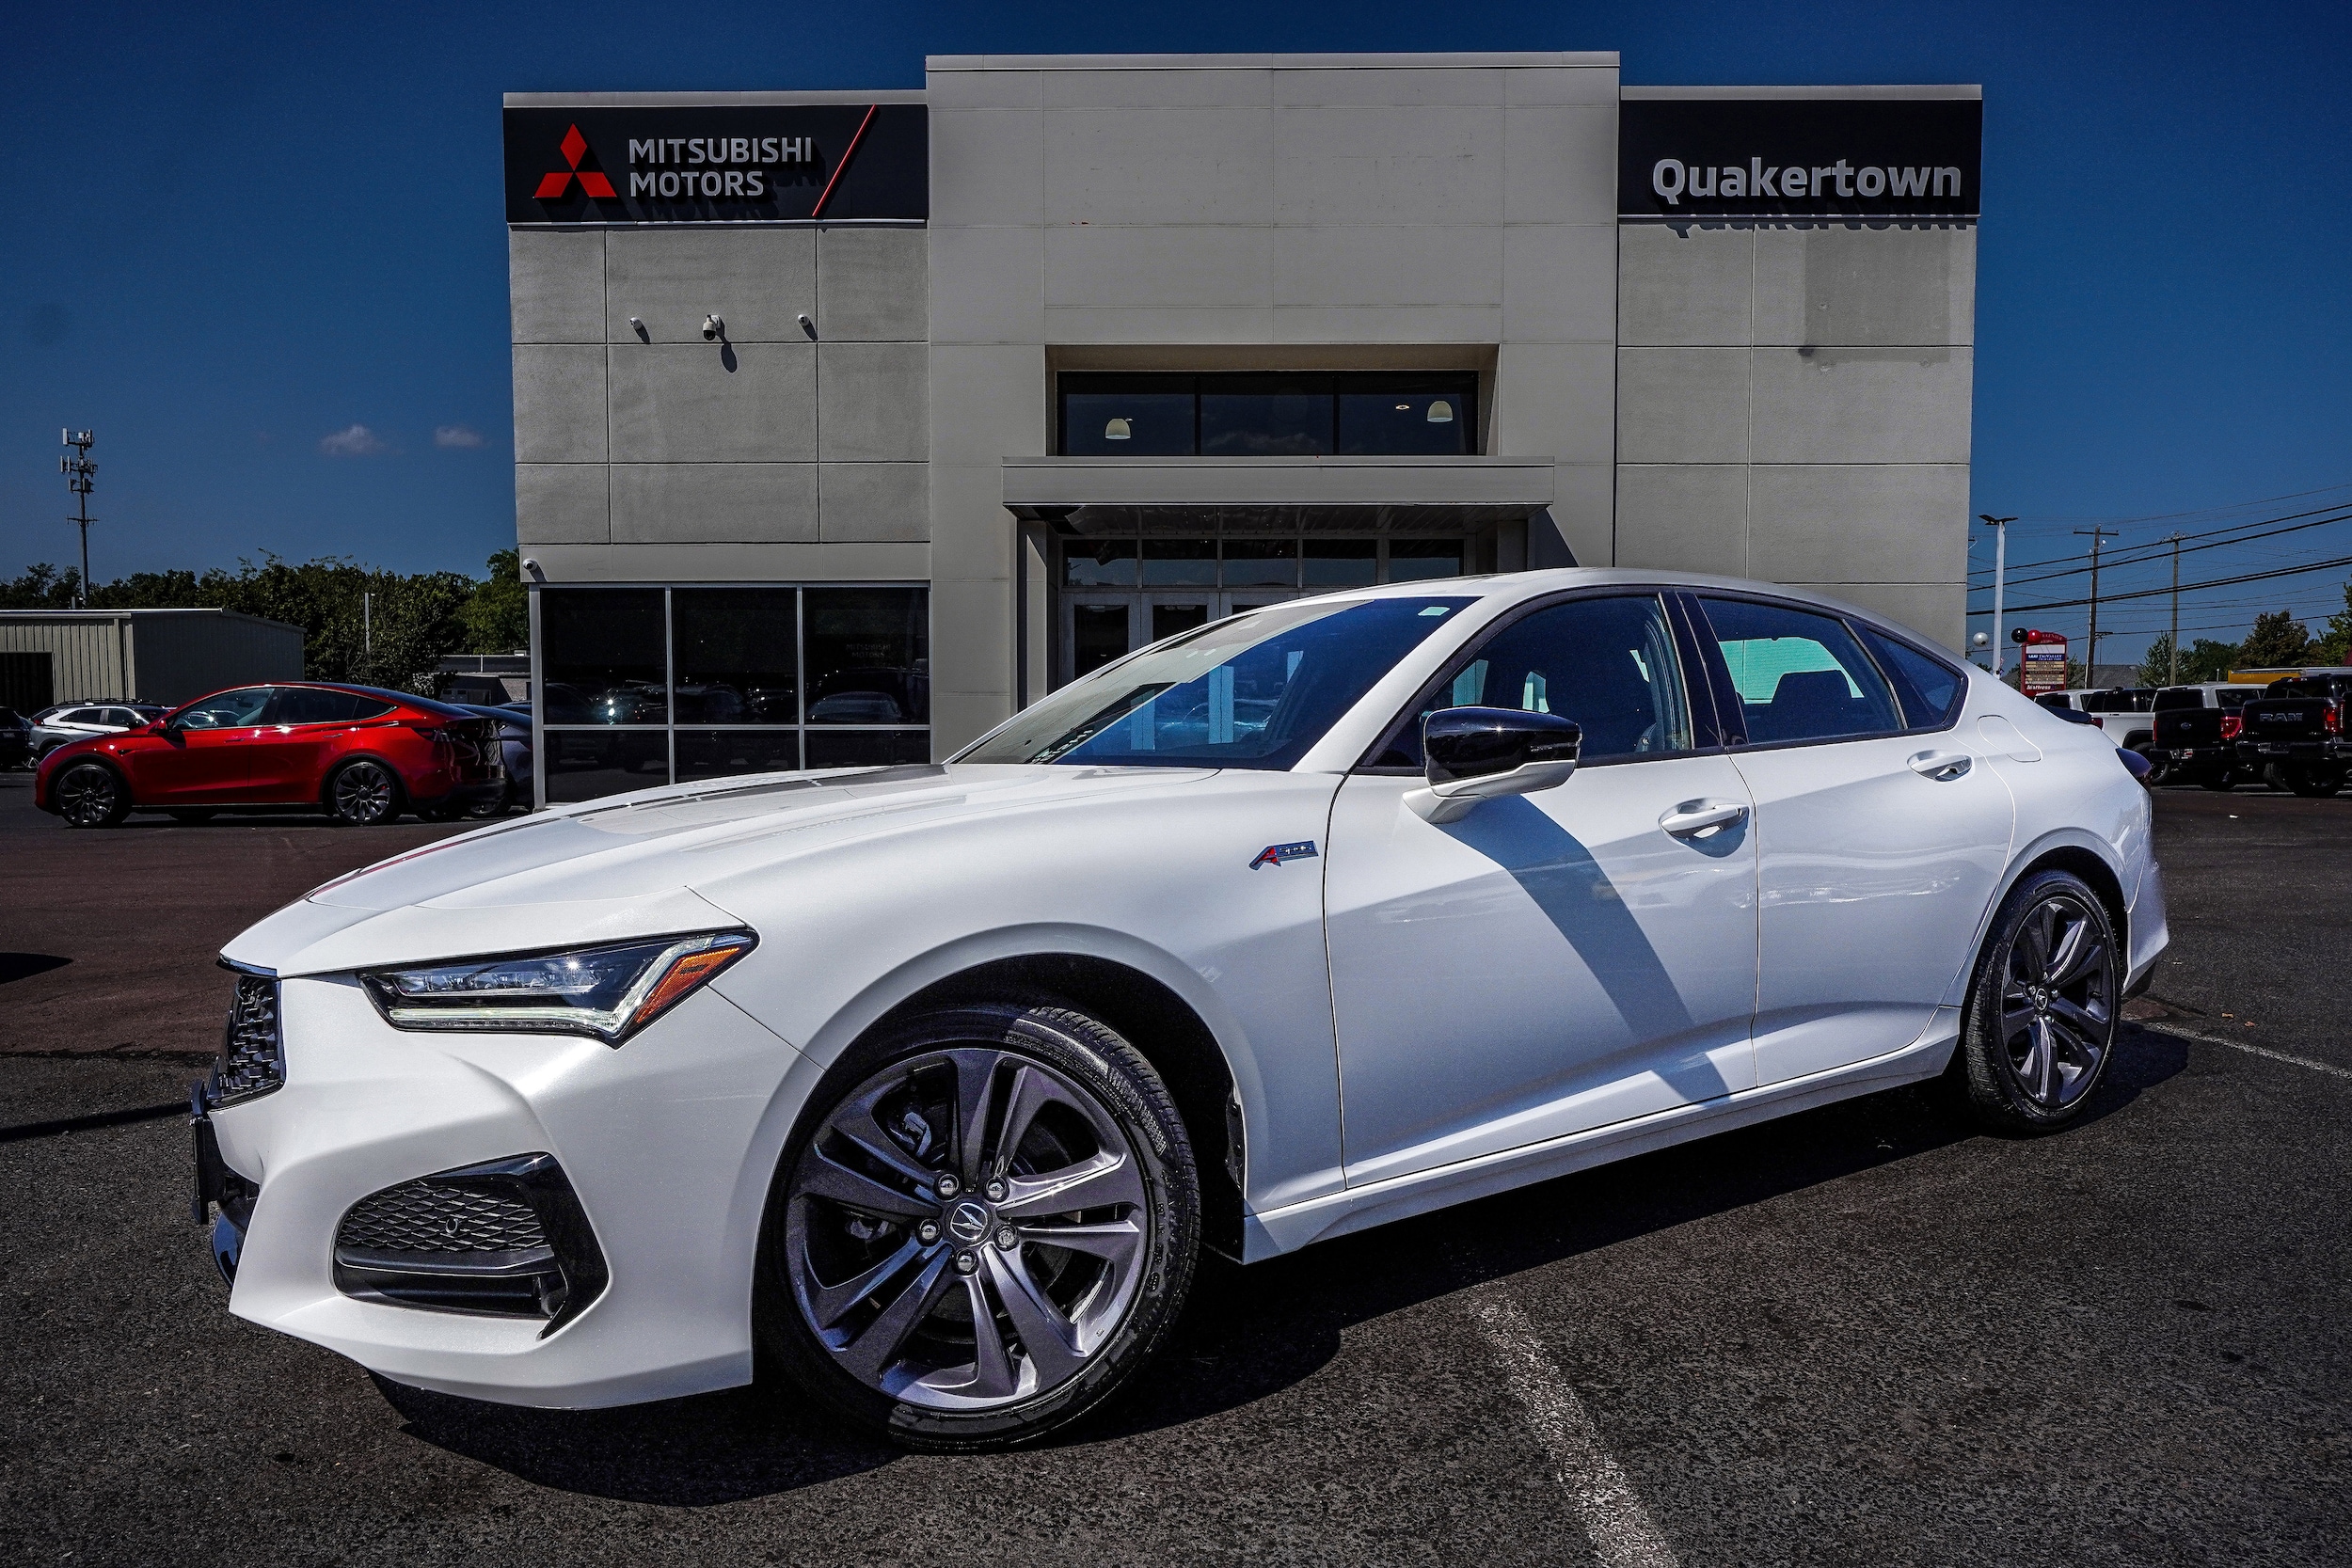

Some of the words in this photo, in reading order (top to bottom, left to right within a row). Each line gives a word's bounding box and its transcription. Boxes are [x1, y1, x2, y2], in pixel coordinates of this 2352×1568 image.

[628, 136, 812, 164] MITSUBISHI
[629, 171, 764, 198] MOTORS
[1652, 157, 1962, 205] Quakertown
[2260, 712, 2303, 722] RAM
